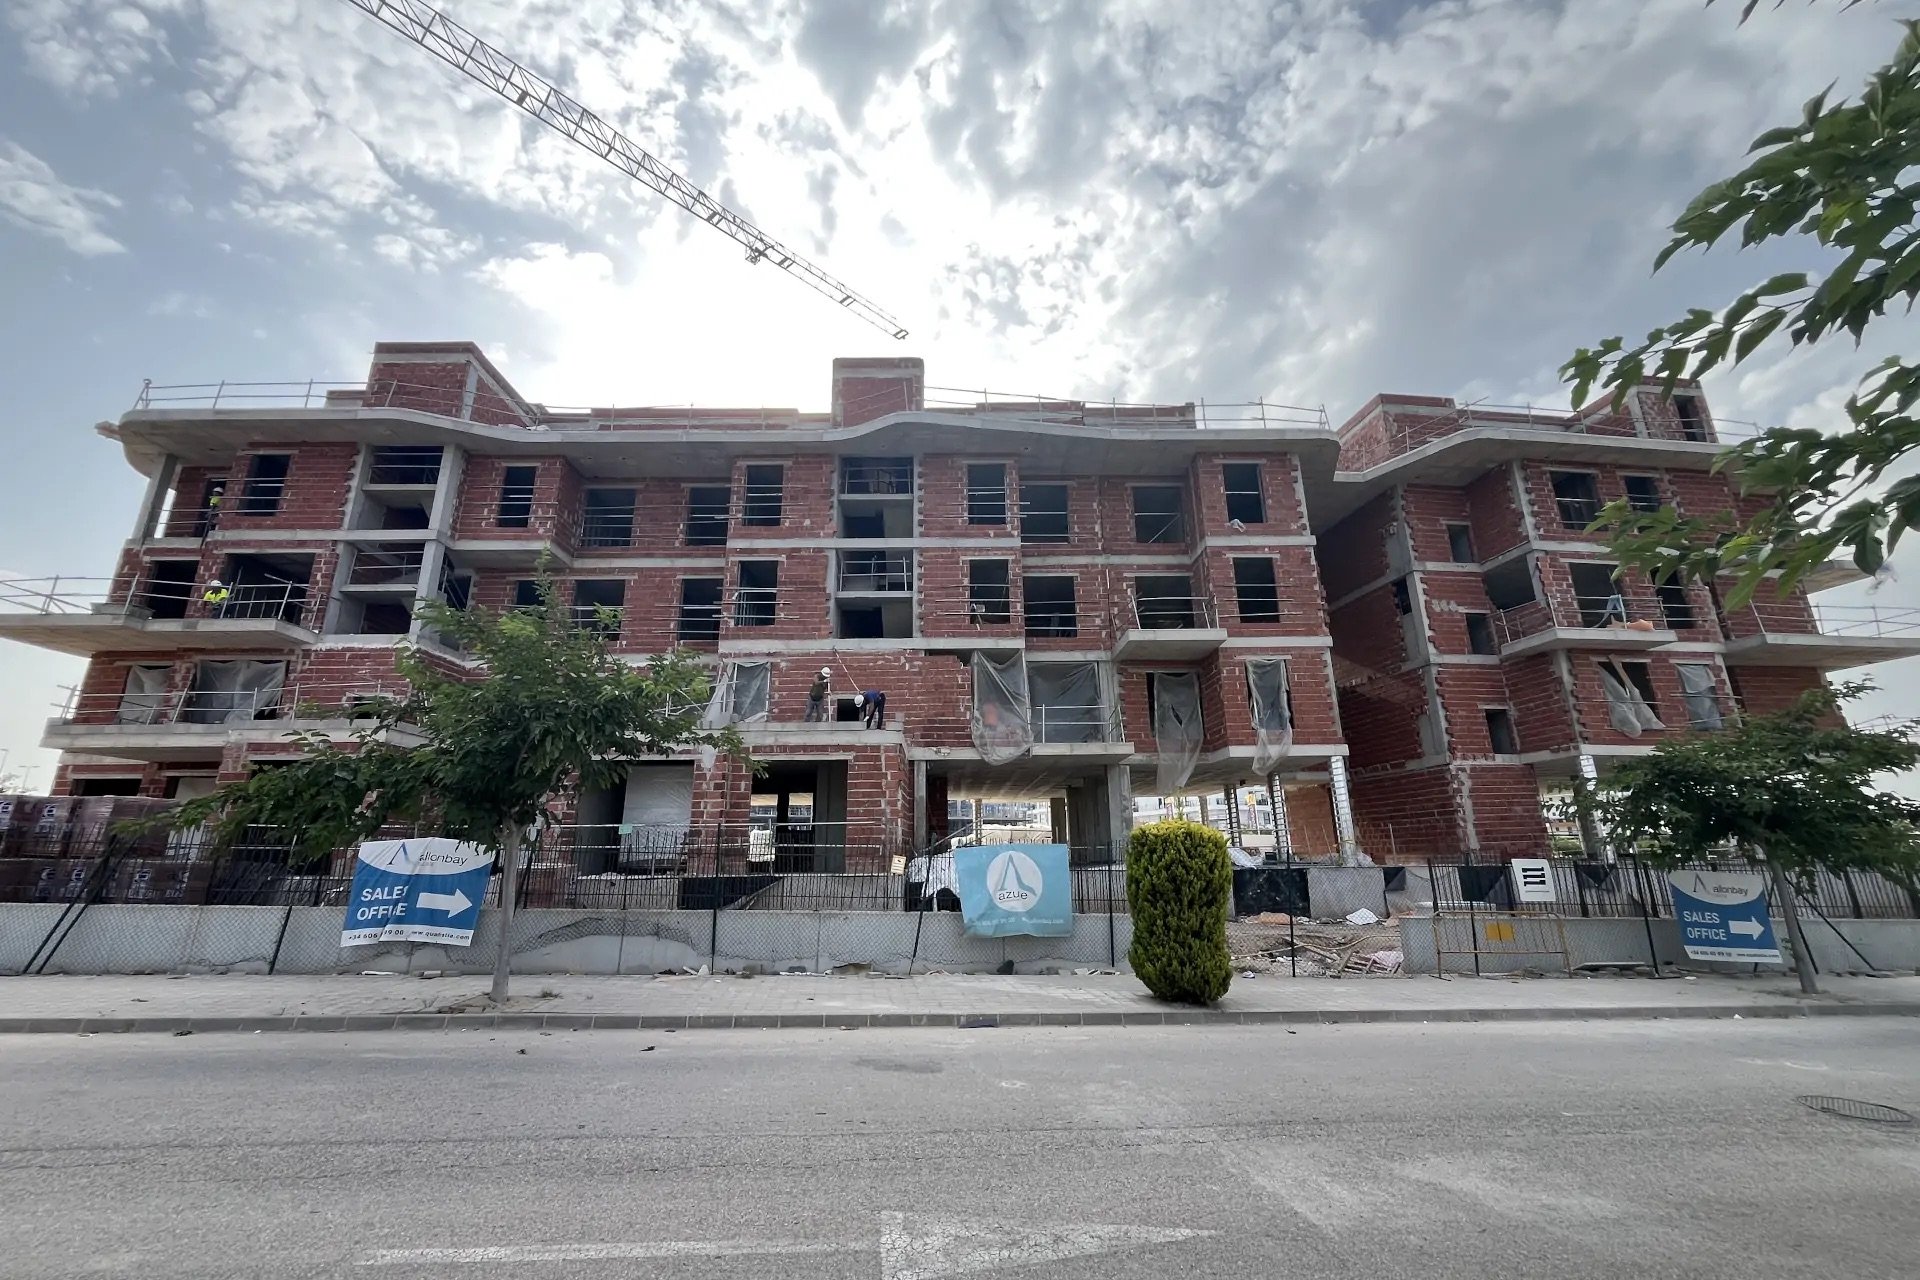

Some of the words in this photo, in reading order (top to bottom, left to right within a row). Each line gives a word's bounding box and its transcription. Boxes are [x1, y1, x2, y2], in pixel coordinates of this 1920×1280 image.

[998, 891, 1028, 901] azue
[1683, 911, 1720, 924] SALES
[1687, 927, 1727, 941] OFFICE
